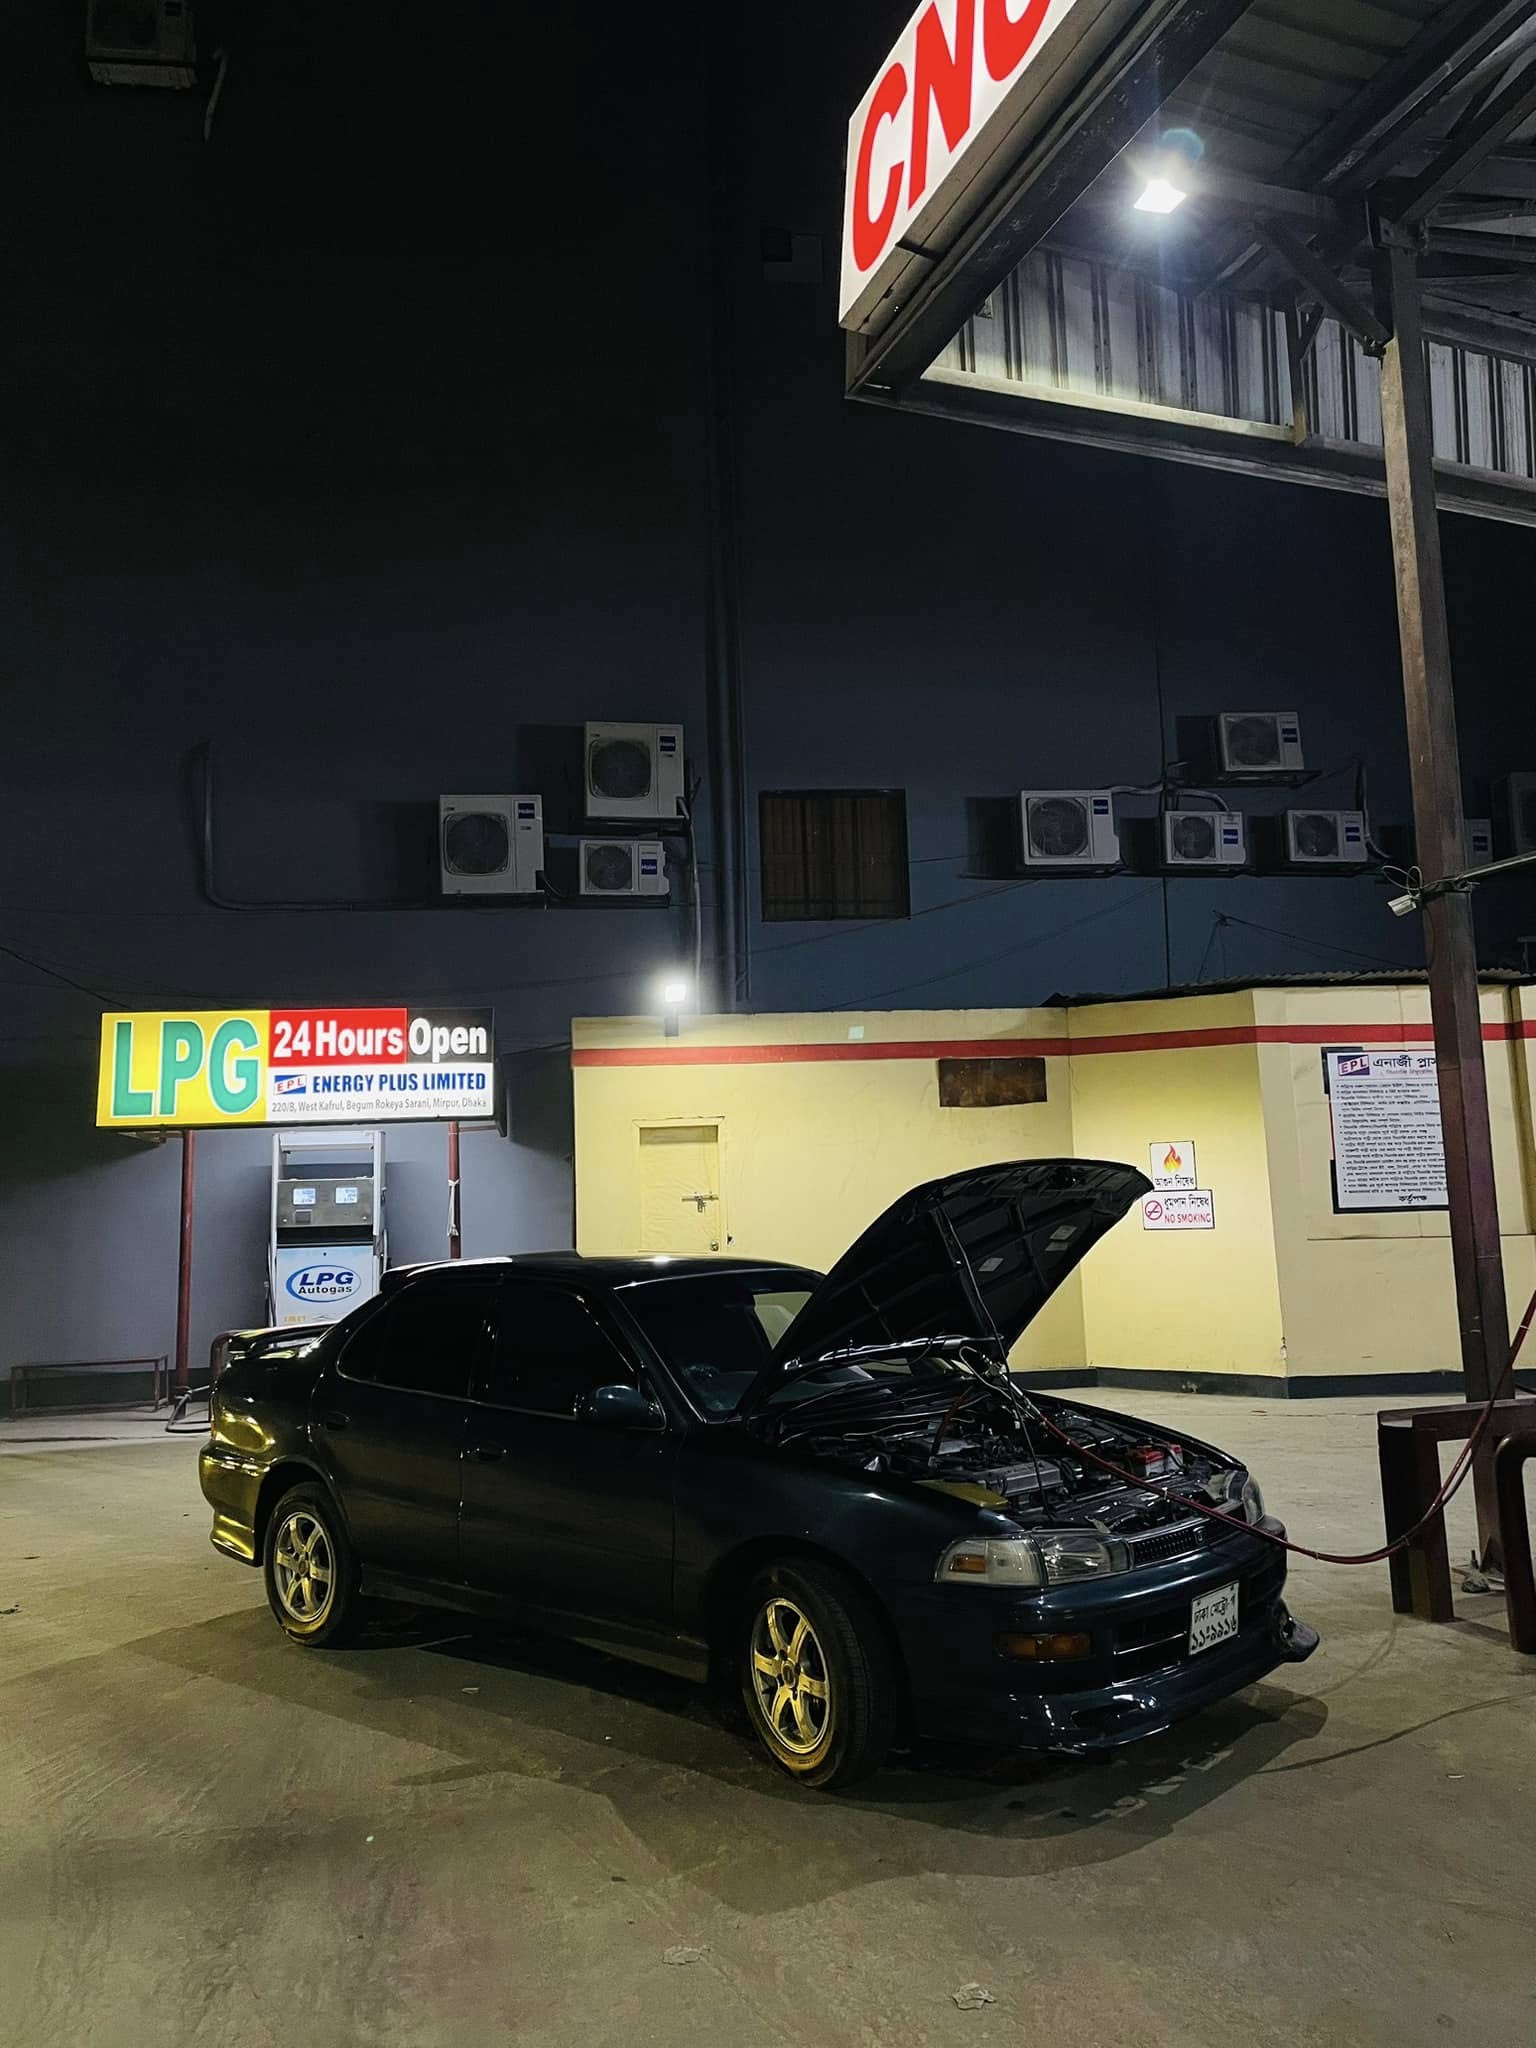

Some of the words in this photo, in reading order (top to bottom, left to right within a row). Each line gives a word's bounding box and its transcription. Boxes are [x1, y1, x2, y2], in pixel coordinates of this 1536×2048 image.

[273, 1020, 311, 1058] 24
[314, 1019, 402, 1056] Hours
[408, 1018, 487, 1063] Open
[111, 1018, 260, 1117] LPG
[1340, 1058, 1368, 1074] EPL
[275, 1077, 305, 1094] EPL
[313, 1074, 374, 1093] ENERGY
[378, 1073, 418, 1091] PLUS
[423, 1072, 486, 1090] LIMITED
[272, 1102, 297, 1113] 220/B,
[299, 1101, 318, 1112] West
[319, 1100, 345, 1112] Kafrul,
[346, 1100, 374, 1114] Begum
[375, 1099, 404, 1112] Rokeya
[405, 1098, 431, 1110] Sarani,
[432, 1097, 460, 1110] Mirpur,
[462, 1097, 487, 1108] Dhaka
[1165, 1213, 1176, 1224] NO
[1177, 1212, 1211, 1224] SMOKING
[299, 1271, 354, 1286] LPG
[298, 1286, 352, 1295] Autogas
[1194, 1605, 1209, 1624] ঢাকা
